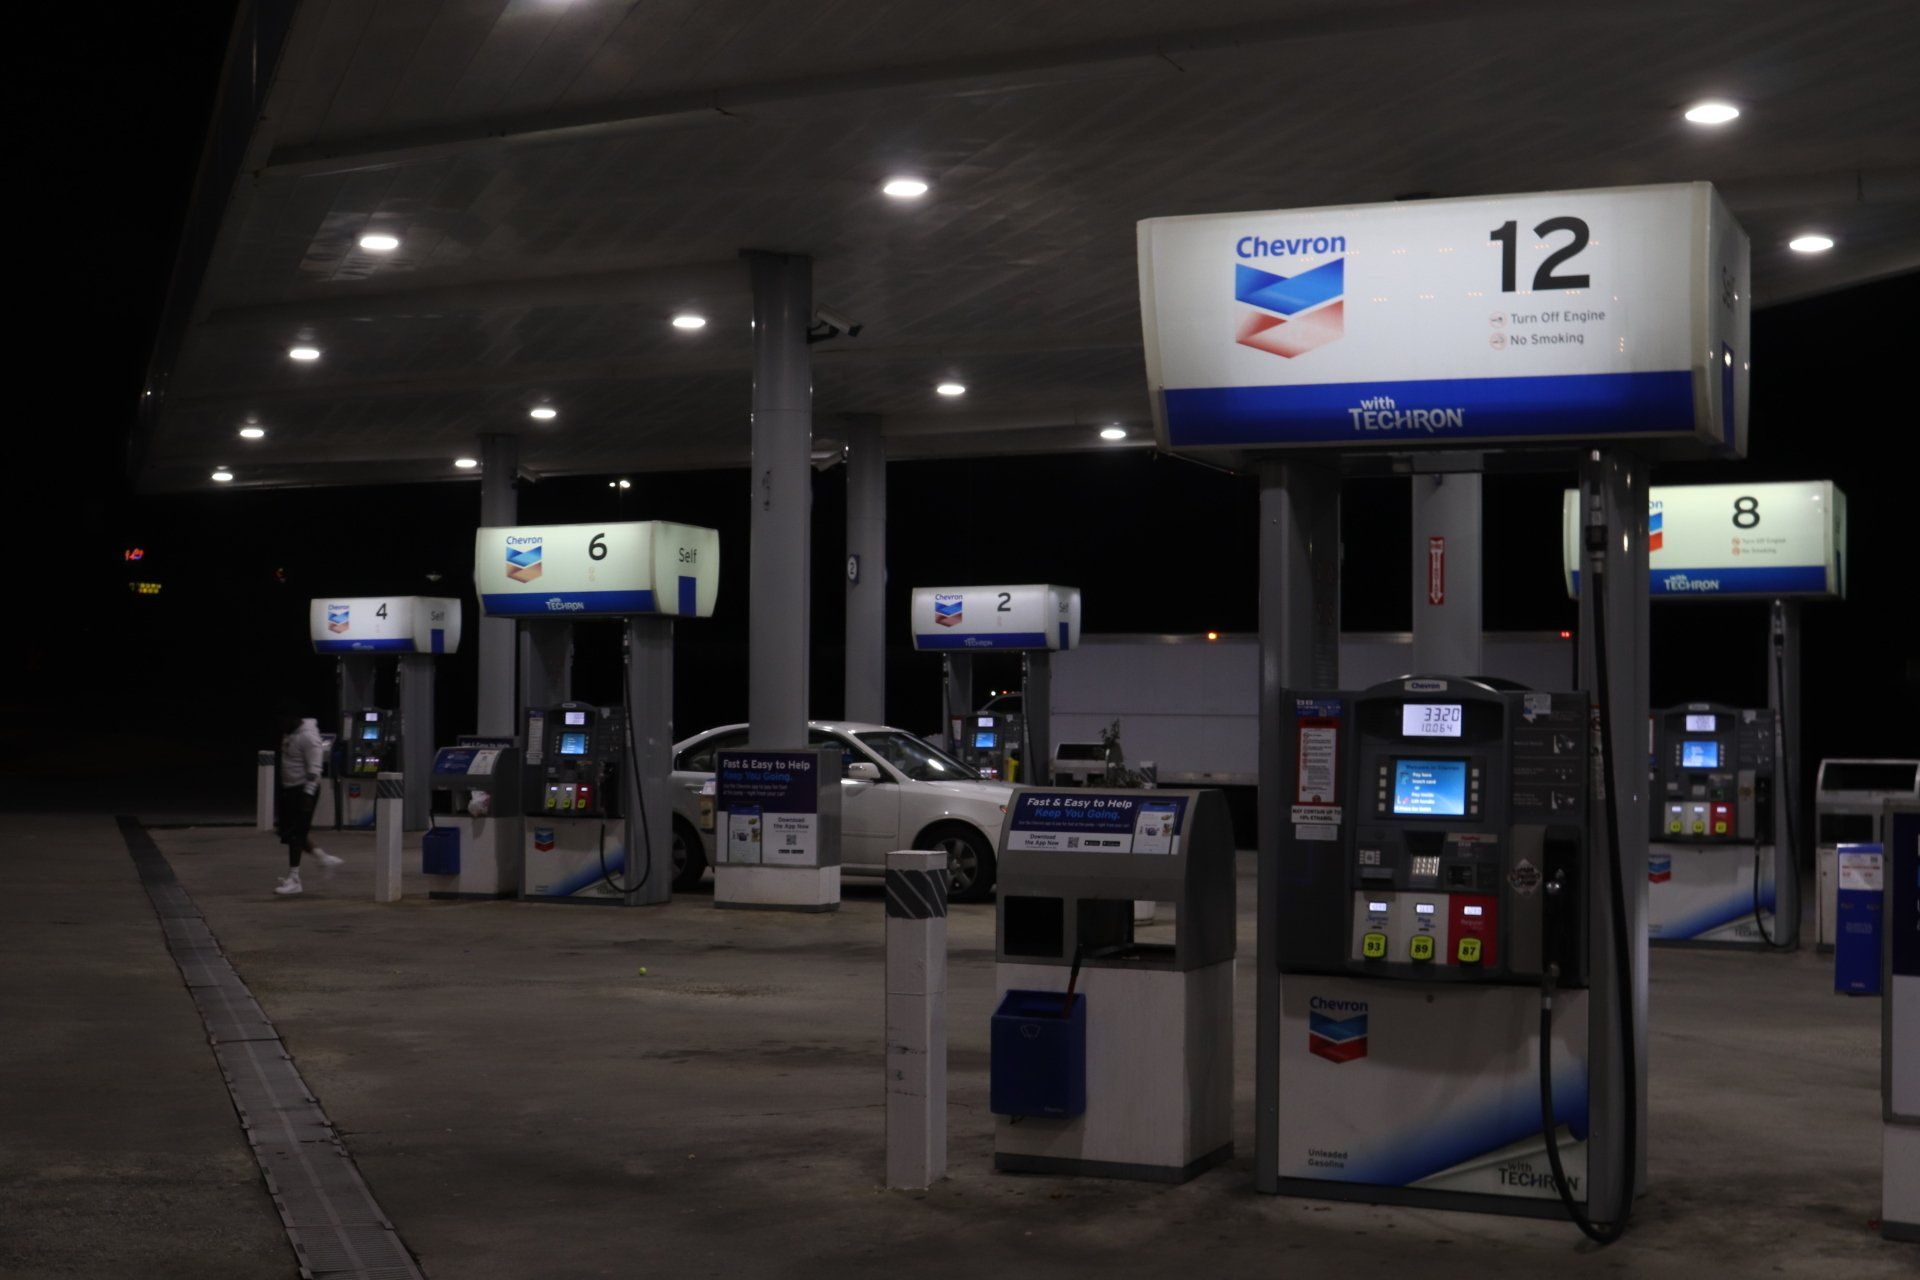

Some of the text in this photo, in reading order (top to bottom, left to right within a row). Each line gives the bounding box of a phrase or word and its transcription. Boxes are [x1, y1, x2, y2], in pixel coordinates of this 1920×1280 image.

[1236, 235, 1346, 259] Chevron
[1490, 215, 1591, 293] 12
[1510, 308, 1606, 326] Turn Off Engine
[1510, 332, 1585, 348] No Smoking
[1360, 396, 1395, 411] with
[1348, 408, 1463, 432] TECHRON
[1732, 496, 1760, 529] 8
[506, 536, 543, 545] Chevron
[589, 532, 608, 561] 6
[678, 547, 698, 565] Self
[1664, 578, 1720, 591] TECHRON
[935, 593, 963, 601] Chevron
[997, 592, 1011, 612] 2
[376, 602, 388, 620] 4
[545, 600, 584, 611] TECHRON
[431, 610, 445, 621] Self
[1411, 682, 1441, 690] Chevron
[723, 759, 810, 771] Fast & Easy to Help
[745, 771, 761, 780] You
[1027, 798, 1132, 810] Fast & Easy to Help
[1034, 809, 1121, 821] Keep You Going.
[1367, 942, 1381, 951] 93
[1414, 944, 1428, 953] 89
[1462, 946, 1476, 955] 87
[1310, 996, 1368, 1012] Chevron
[1308, 1148, 1348, 1160] Unleaded
[1308, 1159, 1345, 1169] Gasoline
[1508, 1161, 1532, 1172] with
[1499, 1168, 1578, 1193] TECHRN
